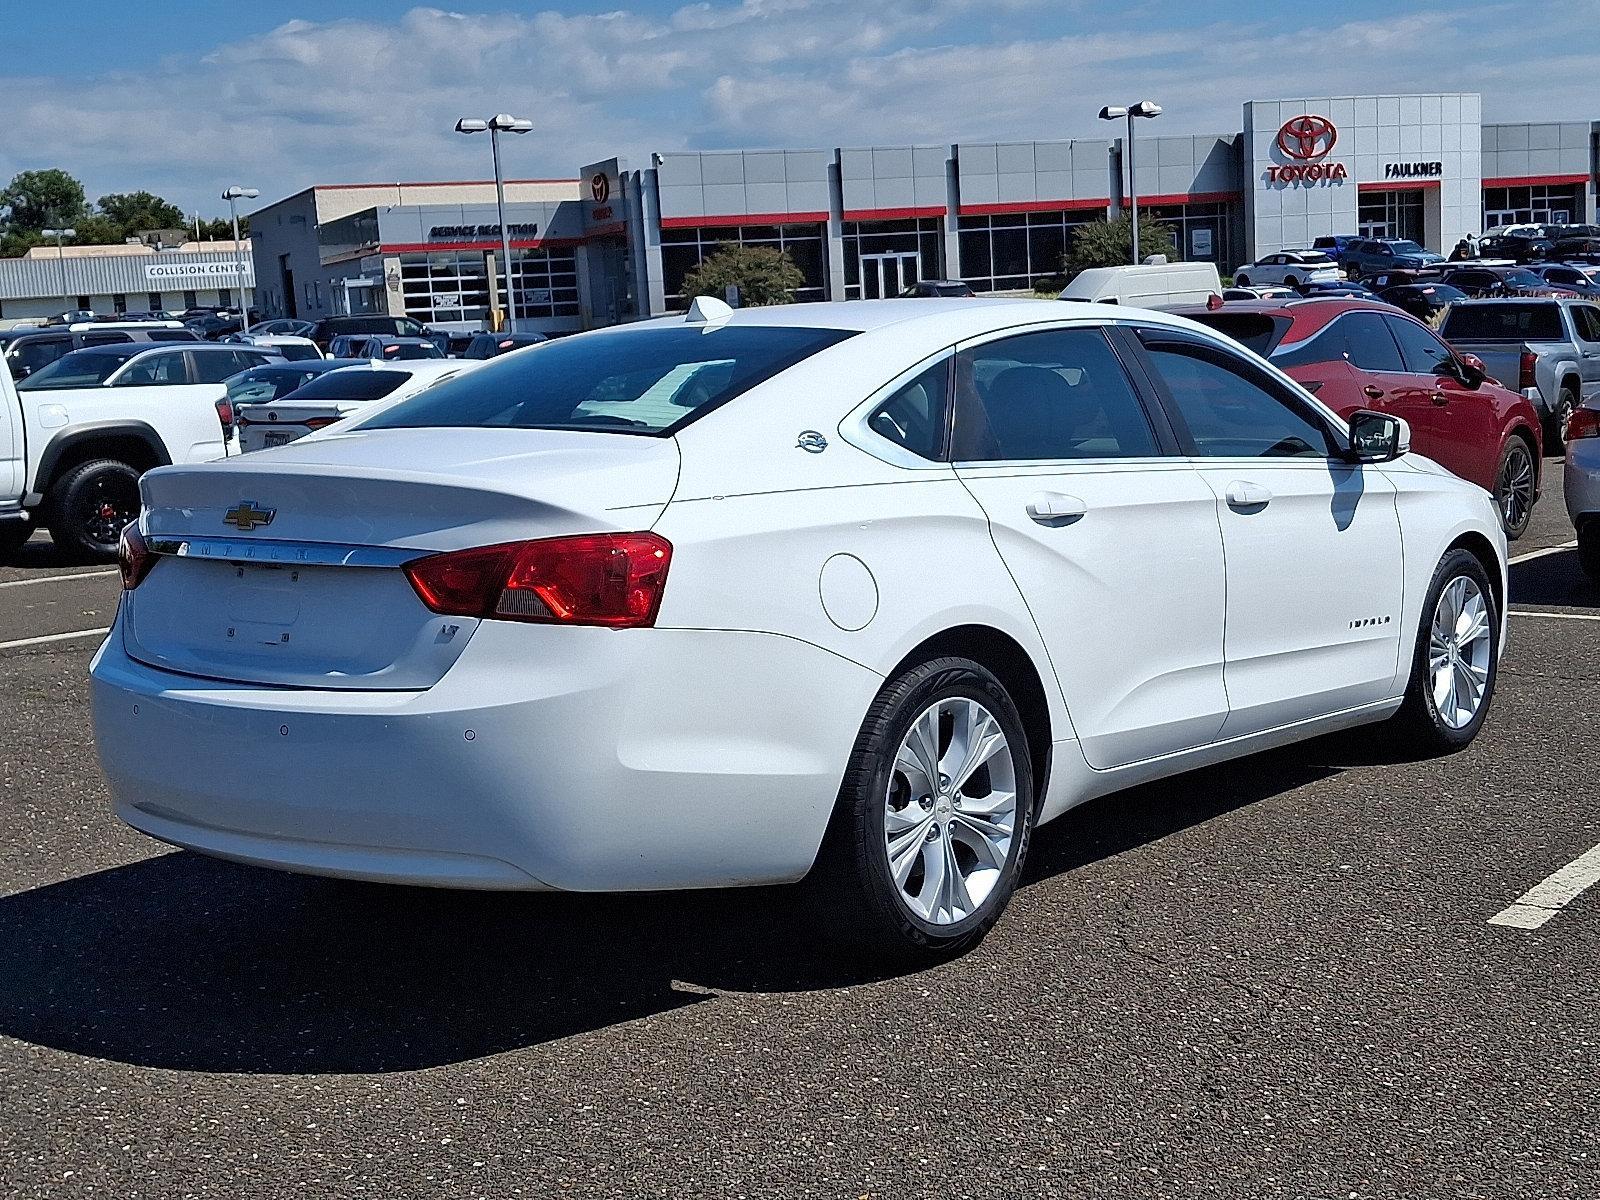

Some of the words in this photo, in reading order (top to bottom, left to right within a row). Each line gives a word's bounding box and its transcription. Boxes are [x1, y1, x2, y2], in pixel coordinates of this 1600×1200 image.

[1266, 163, 1348, 183] TOYOTA
[1385, 162, 1442, 179] FAULKNER
[430, 225, 477, 237] SERVICE
[149, 265, 206, 276] COLLISION
[1349, 615, 1391, 630] IMPALA
